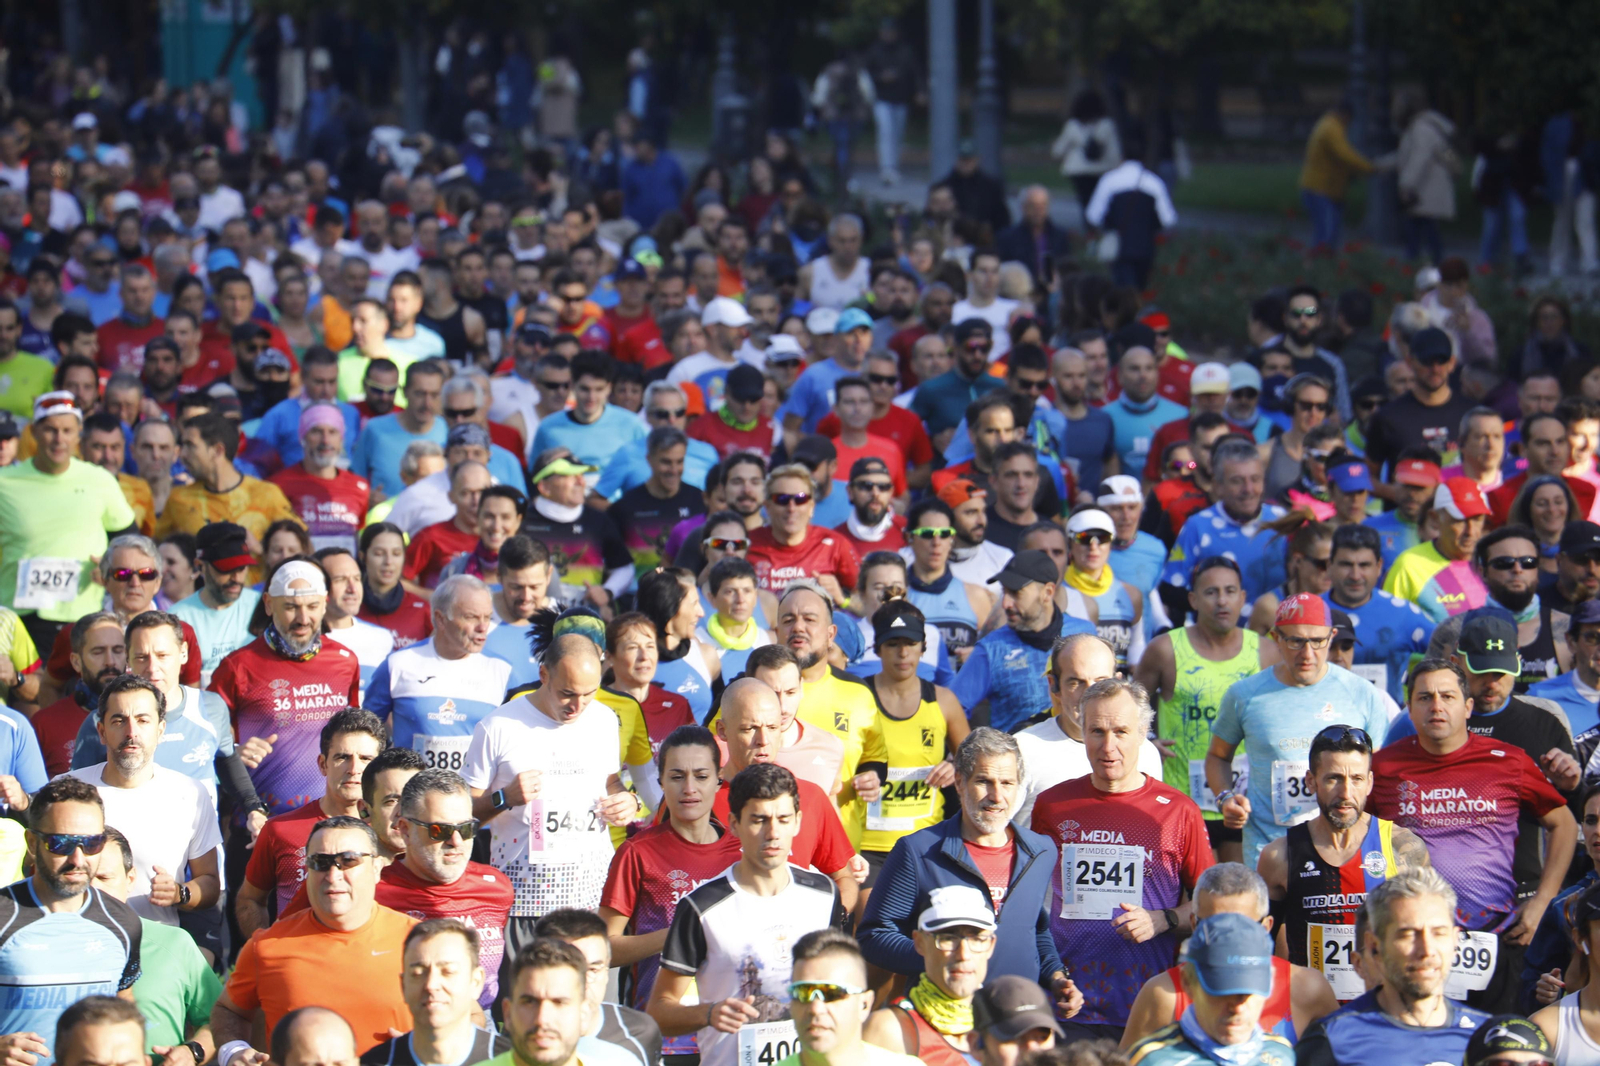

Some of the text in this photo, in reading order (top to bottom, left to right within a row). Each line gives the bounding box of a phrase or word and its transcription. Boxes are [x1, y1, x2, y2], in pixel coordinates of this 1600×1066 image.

[31, 570, 74, 587] 3267
[771, 567, 805, 578] MEDIA
[293, 684, 332, 697] MEDIA
[274, 692, 348, 711] 36 MARATÓN
[425, 750, 467, 770] 388
[881, 781, 931, 802] 2442
[1421, 787, 1467, 801] MEDIA
[1398, 796, 1497, 815] 36 MARATÓN
[1421, 817, 1472, 828] CÓRDOBA
[1081, 830, 1125, 844] MEDIA
[1085, 847, 1117, 856] IMDECO
[1076, 860, 1135, 887] 2541
[1302, 894, 1327, 909] MTB
[1327, 893, 1346, 907] LA
[1324, 940, 1353, 965] 21
[4, 986, 69, 1010] MEDIA
